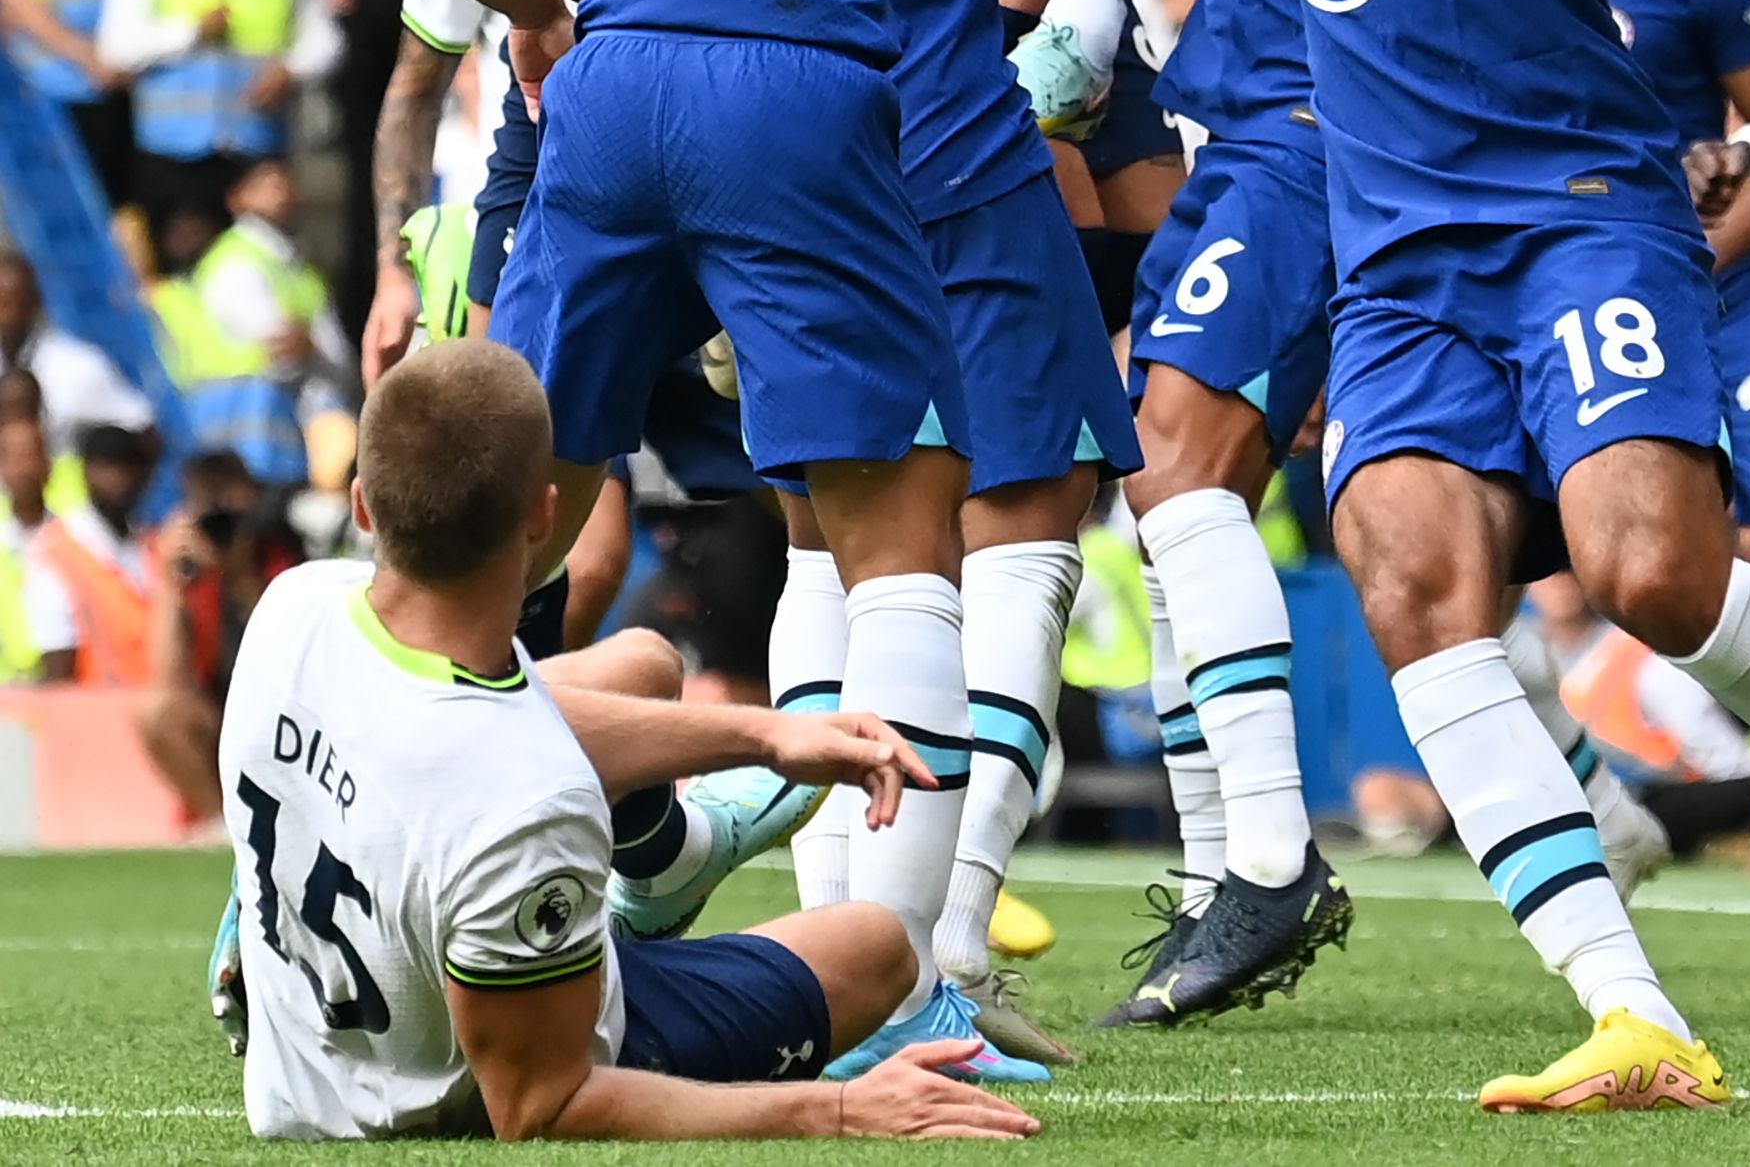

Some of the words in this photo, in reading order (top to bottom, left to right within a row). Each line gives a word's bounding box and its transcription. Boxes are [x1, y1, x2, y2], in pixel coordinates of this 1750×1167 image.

[1175, 236, 1246, 316] 6
[1553, 297, 1666, 396] 18
[273, 713, 357, 824] DIER
[236, 769, 392, 1036] 15
